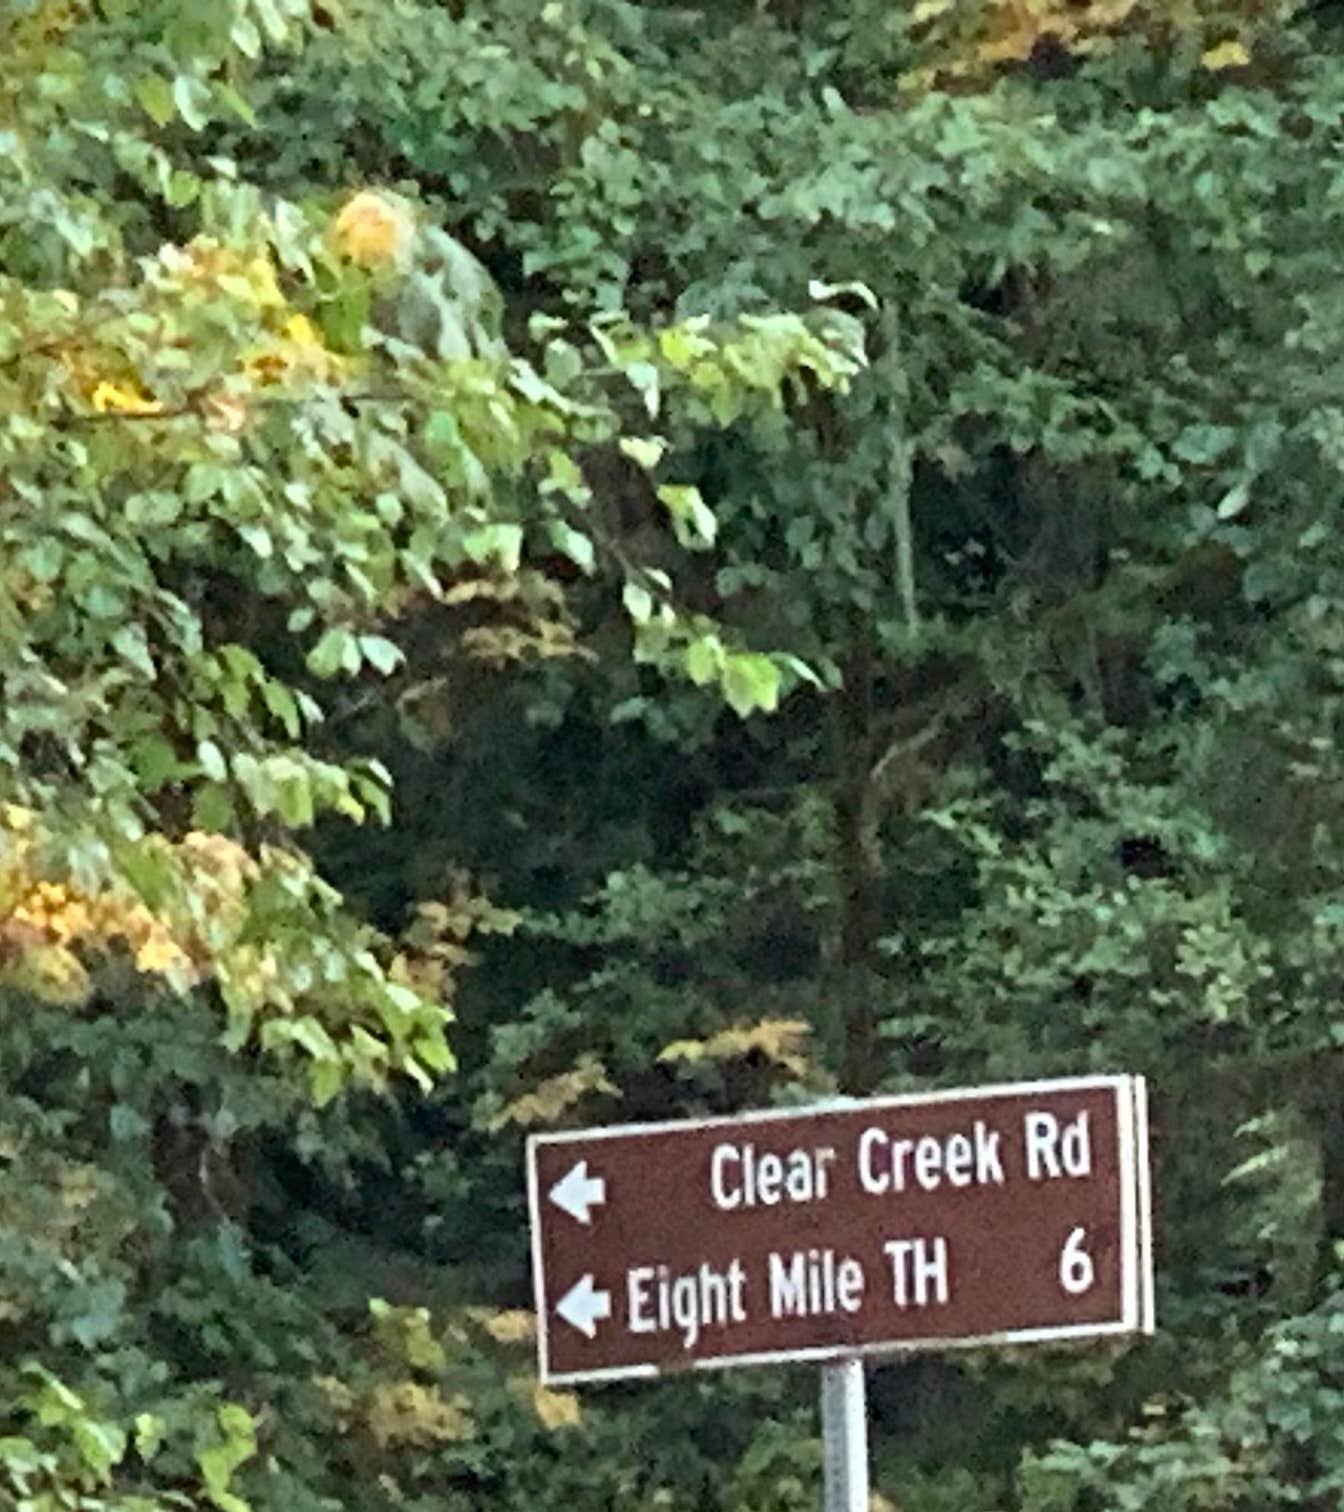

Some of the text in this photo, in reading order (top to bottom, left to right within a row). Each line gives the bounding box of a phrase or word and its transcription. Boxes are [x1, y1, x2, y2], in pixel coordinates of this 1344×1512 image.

[712, 1110, 1090, 1210] Clear Creek Rd
[628, 1228, 1093, 1349] Eight Mile TH 6
